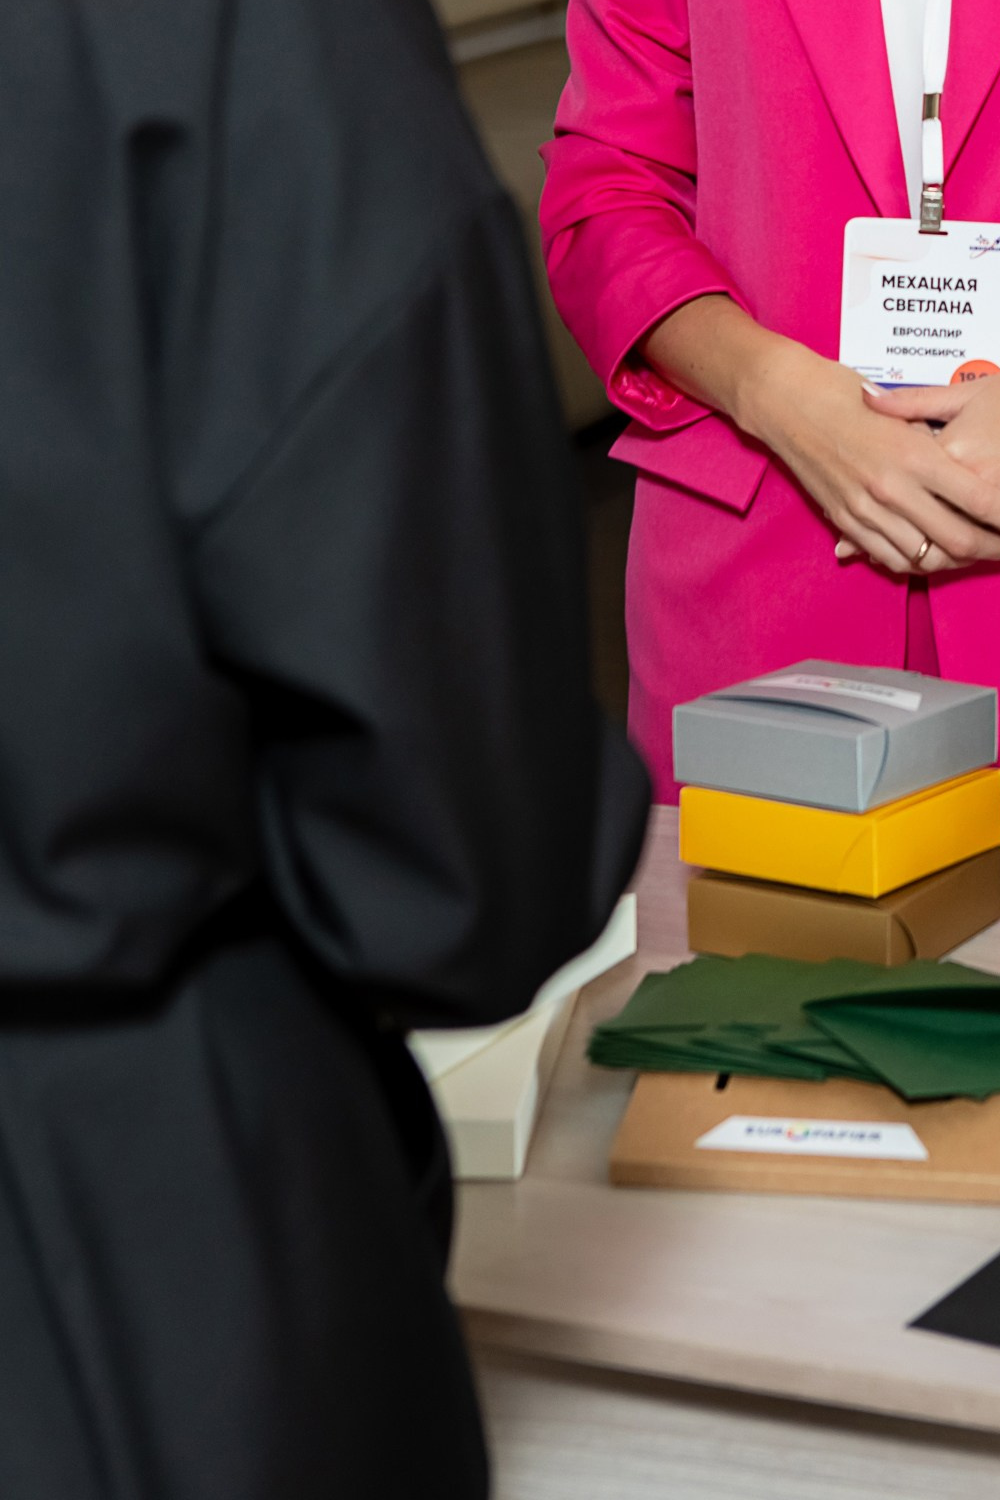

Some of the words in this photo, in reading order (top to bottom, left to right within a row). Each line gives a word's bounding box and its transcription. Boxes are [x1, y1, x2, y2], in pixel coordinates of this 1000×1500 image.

[881, 274, 978, 292] МЕХАЦКАЯ
[883, 297, 974, 315] СВЕТЛАНА
[892, 326, 963, 339] ЕВРОПАПИР
[886, 347, 966, 358] НОВОСИБИРСК
